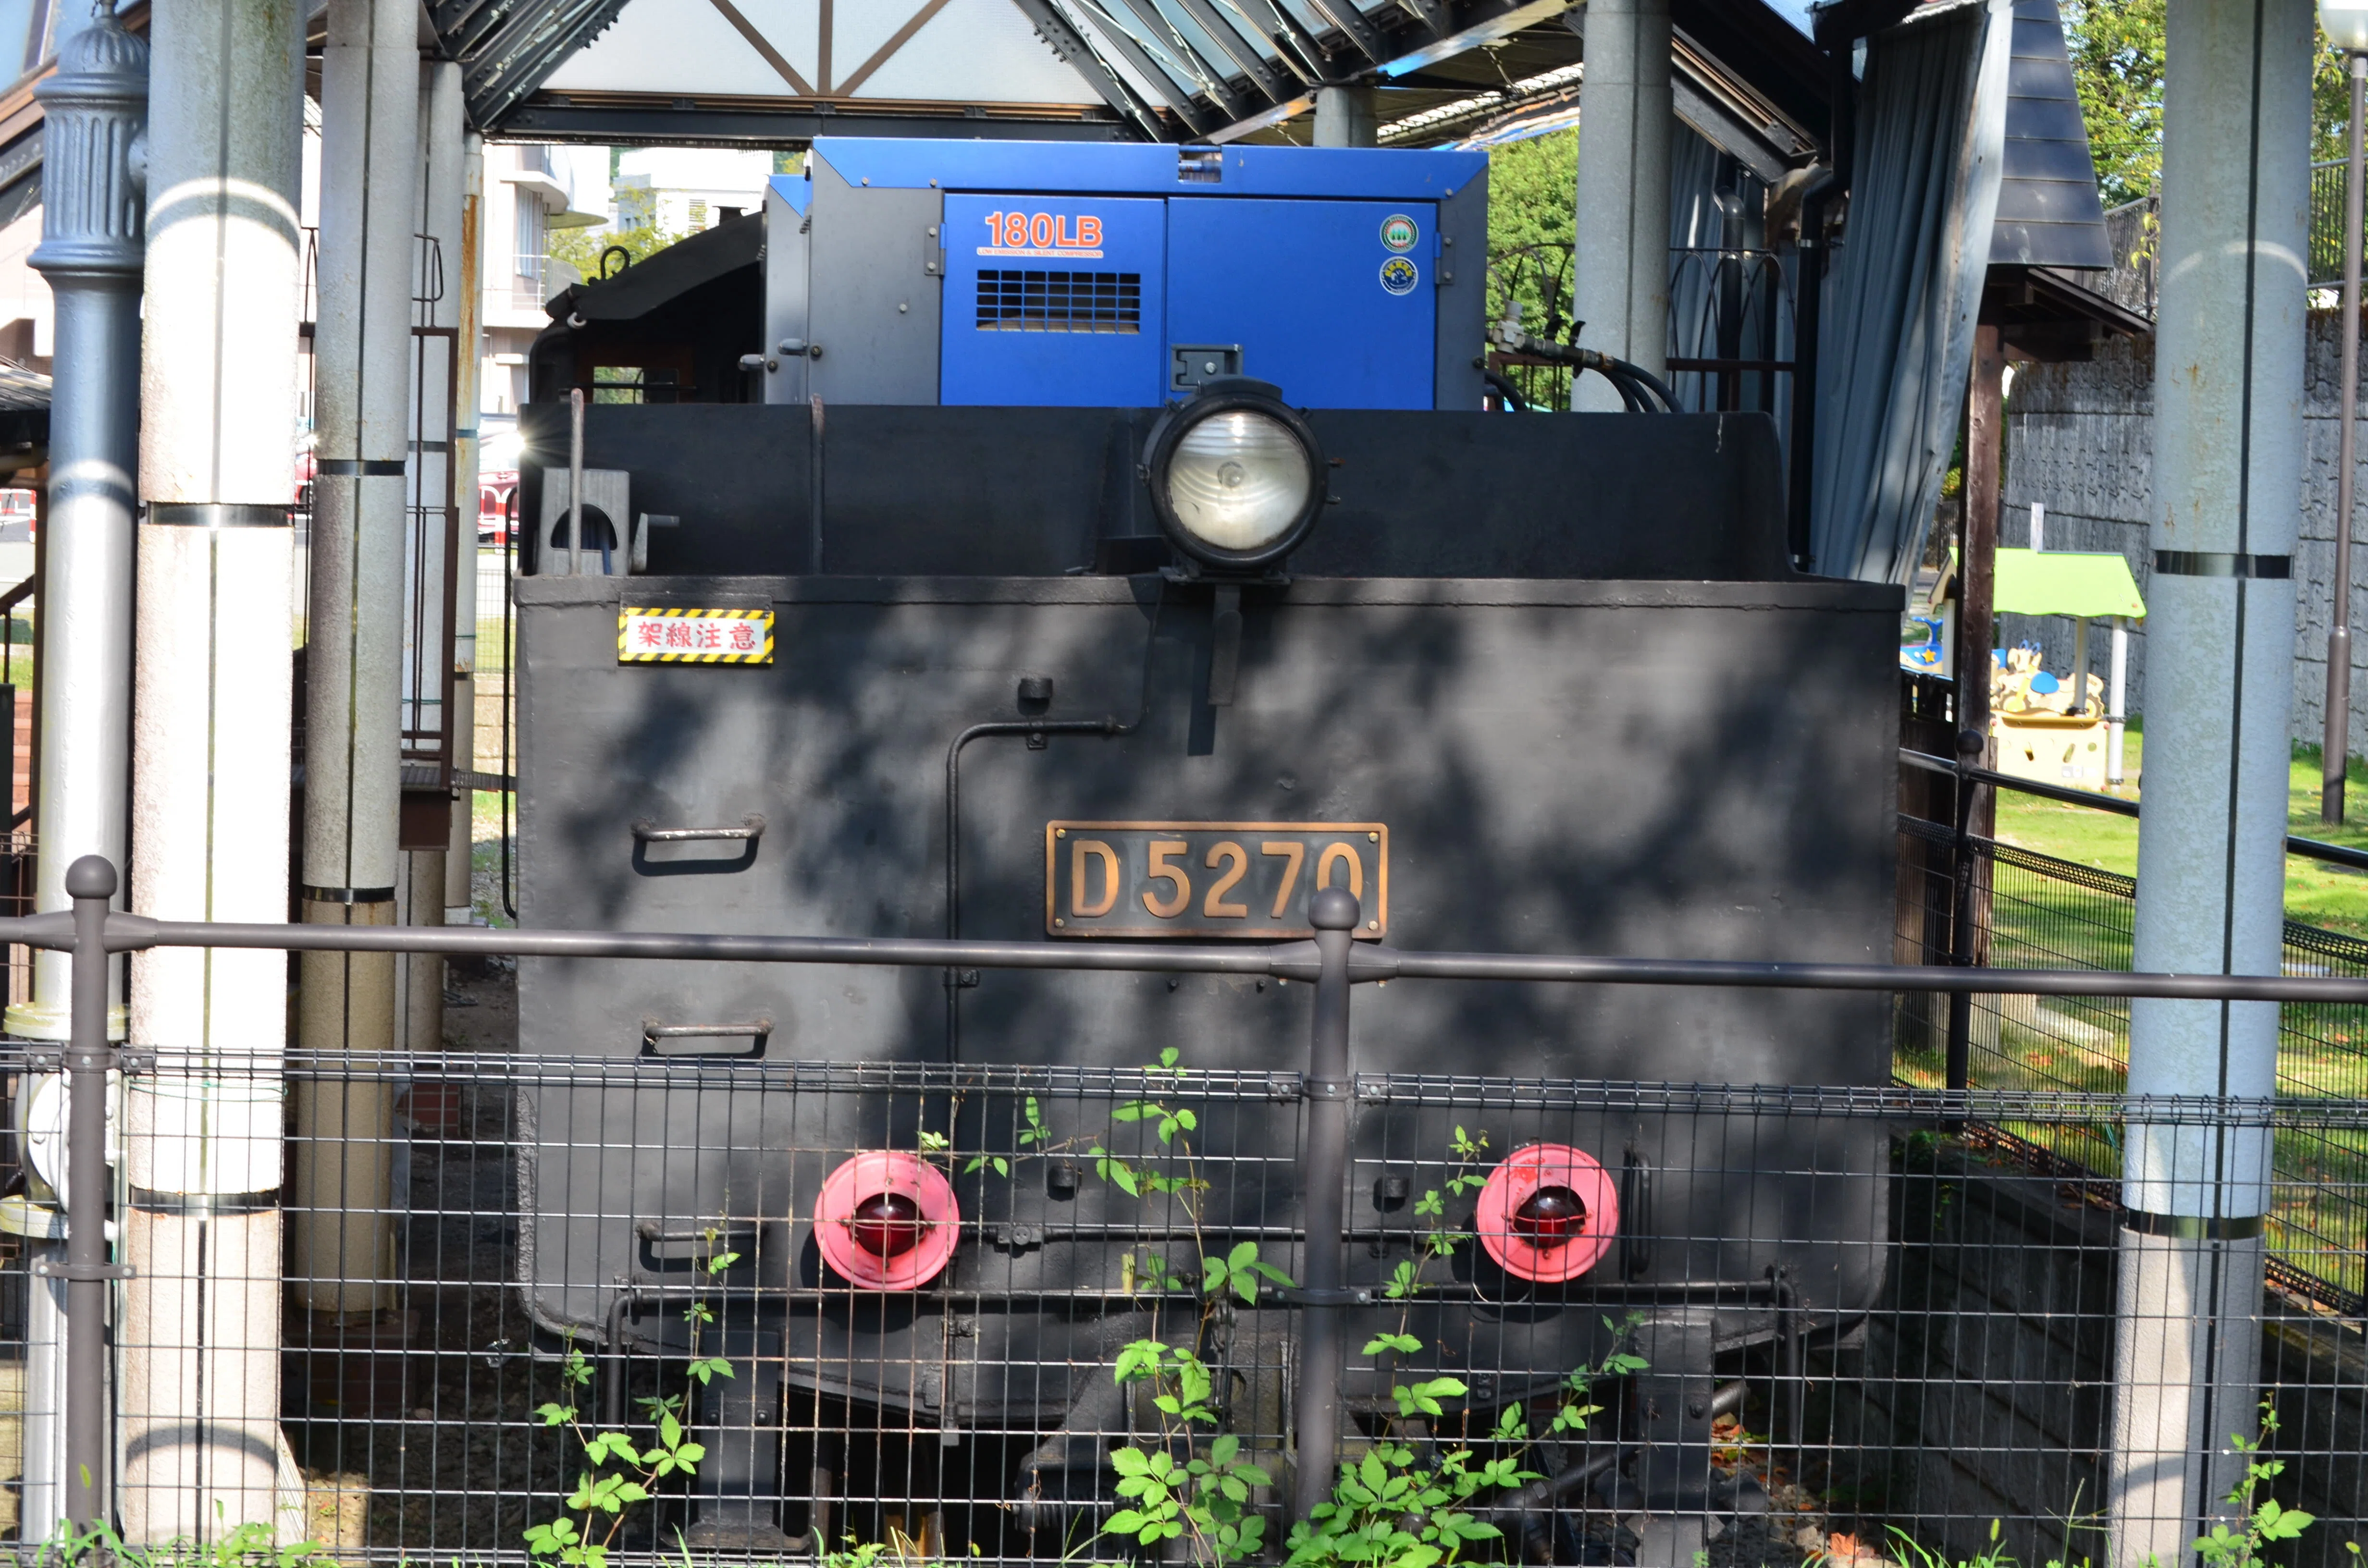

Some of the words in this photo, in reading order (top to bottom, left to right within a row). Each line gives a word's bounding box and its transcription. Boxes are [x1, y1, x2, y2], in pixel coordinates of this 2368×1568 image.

[986, 211, 1102, 248] 180LB
[638, 621, 756, 650] 架線注意
